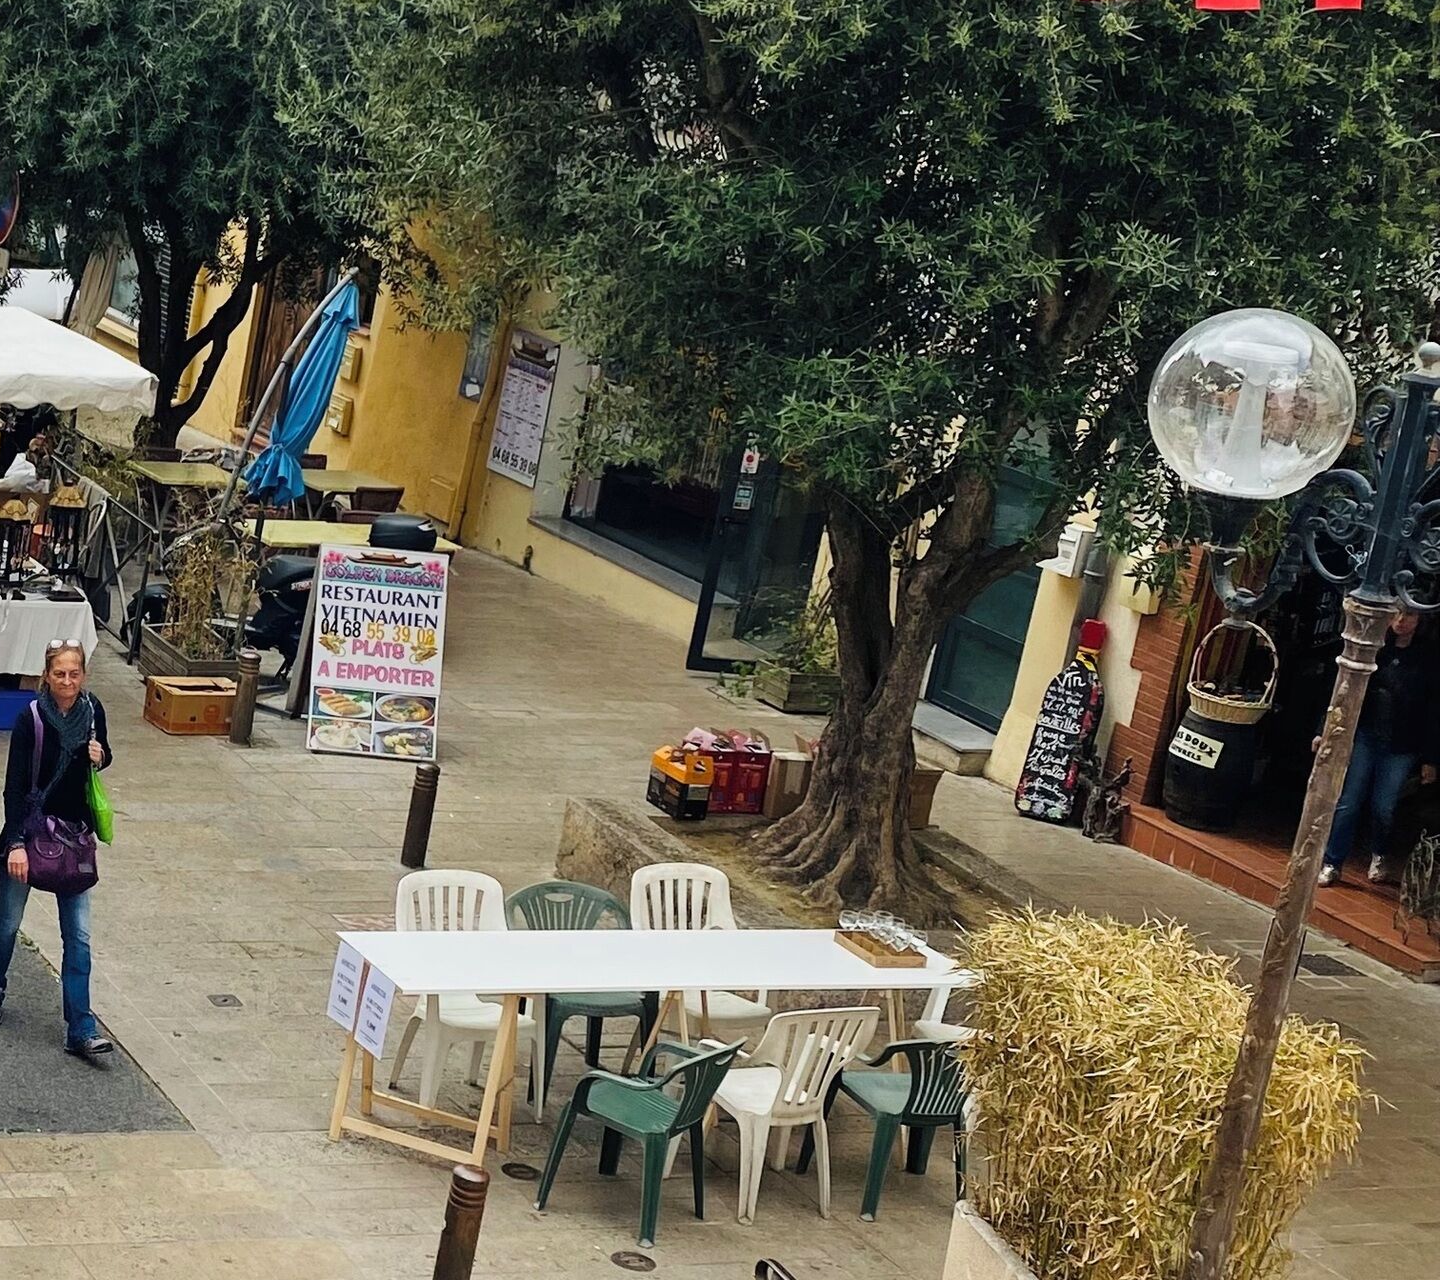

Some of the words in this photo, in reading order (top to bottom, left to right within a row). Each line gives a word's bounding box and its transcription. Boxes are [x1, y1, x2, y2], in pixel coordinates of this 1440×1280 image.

[492, 445, 502, 460] 04
[385, 568, 441, 588] DRAGON
[321, 584, 442, 610] RESTAURANT
[321, 604, 438, 629] VIETNAMIEN
[321, 618, 338, 636] 04
[343, 620, 361, 638] 68
[367, 623, 385, 640] 55
[392, 625, 411, 643] 39
[417, 628, 435, 646] 08
[351, 639, 405, 660] PLATS
[317, 660, 330, 677] A
[336, 662, 435, 688] EMPORTER
[1036, 726, 1066, 746] Rouge
[1185, 734, 1217, 758] DOUX
[1029, 748, 1069, 766] Muscat
